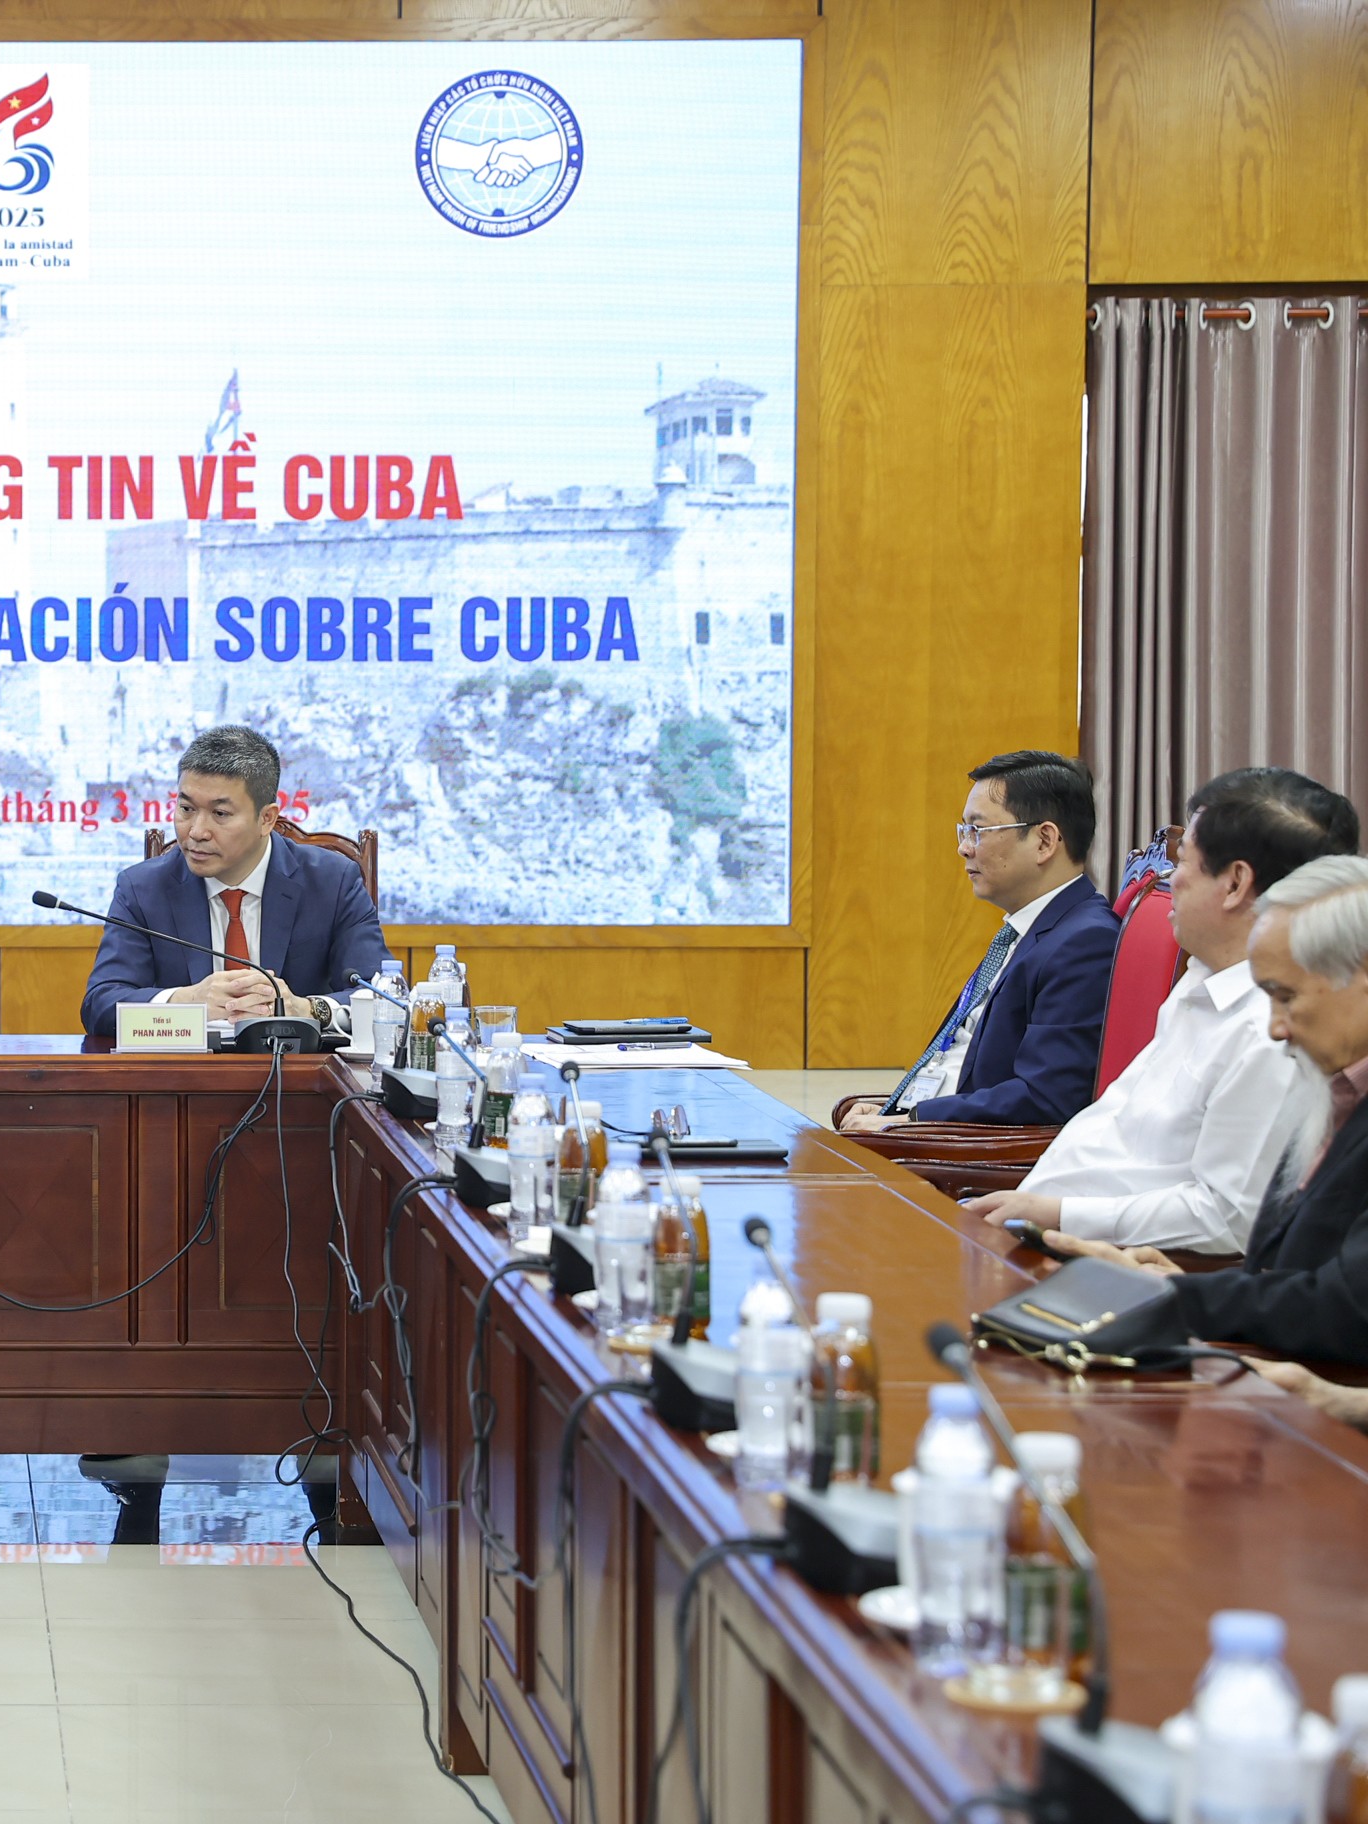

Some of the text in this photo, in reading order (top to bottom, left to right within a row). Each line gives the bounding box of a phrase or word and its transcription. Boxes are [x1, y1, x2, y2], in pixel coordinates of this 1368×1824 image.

[4, 239, 16, 250] la
[20, 239, 73, 250] amistad
[30, 254, 71, 267] Cuba
[47, 455, 154, 520] TIN
[179, 432, 257, 521] VỀ
[283, 454, 464, 521] CUBA
[214, 596, 434, 663] SOBRE
[460, 596, 640, 663] CUBA
[1, 790, 100, 832] tháng
[110, 789, 130, 823] 3
[132, 1028, 192, 1037] PHAN ANH SƠN
